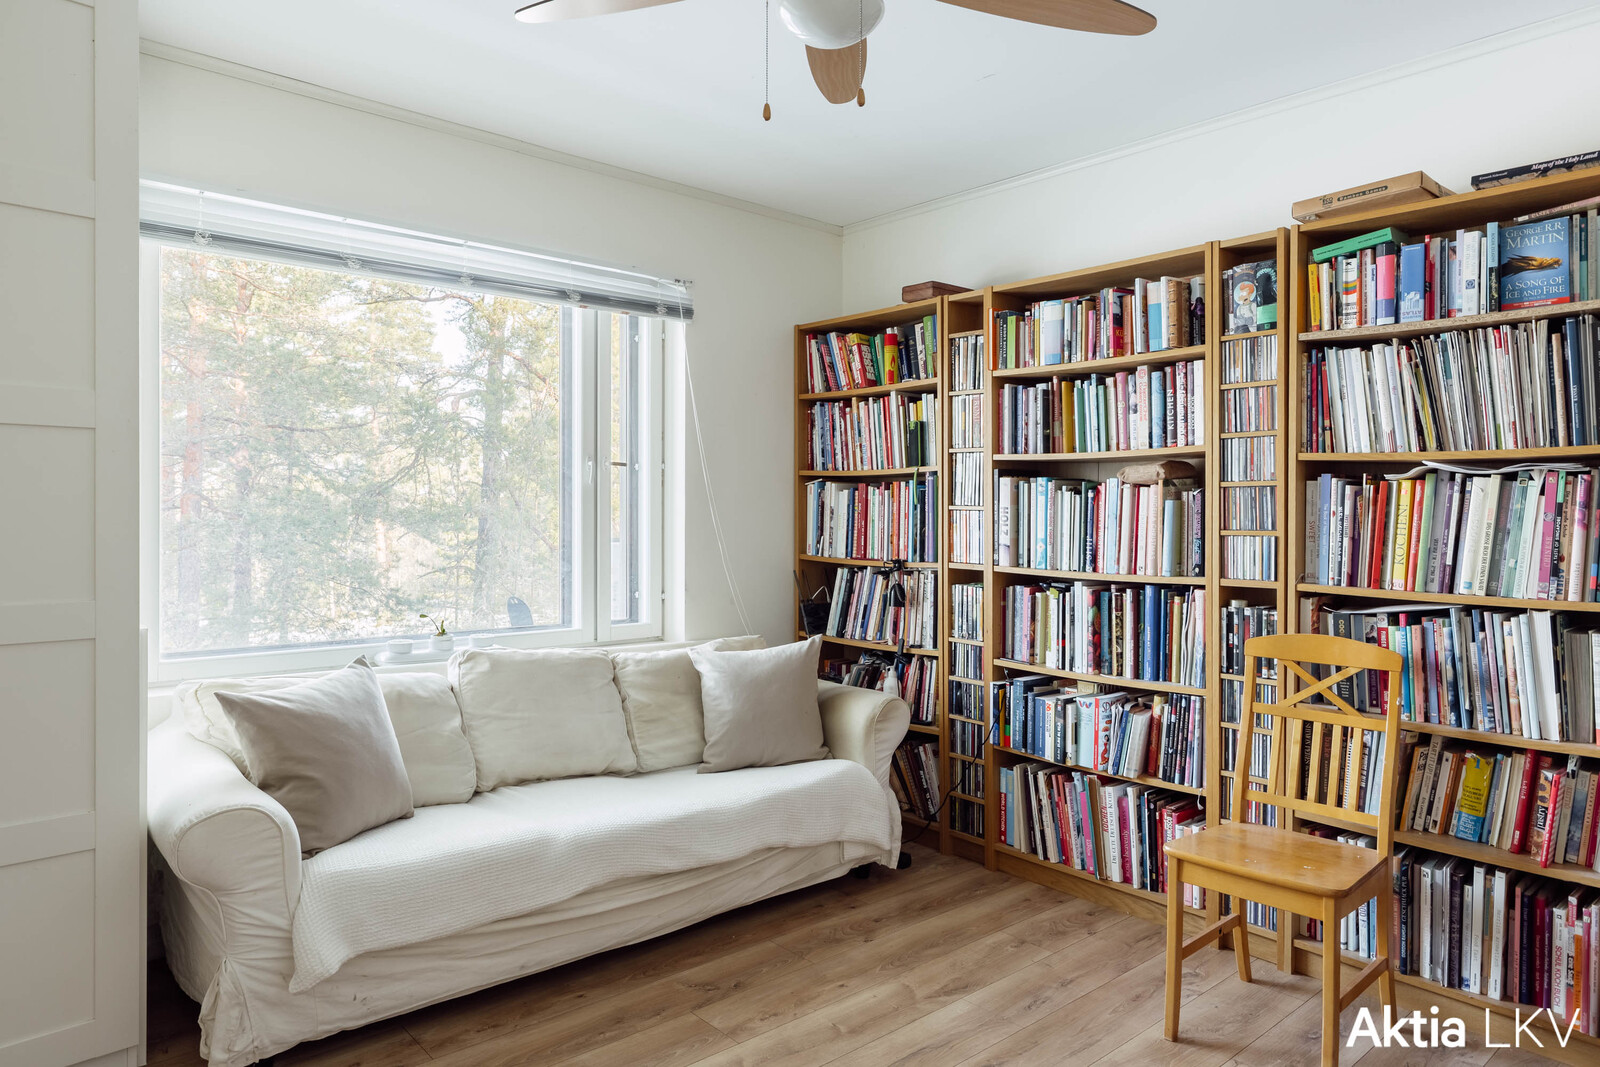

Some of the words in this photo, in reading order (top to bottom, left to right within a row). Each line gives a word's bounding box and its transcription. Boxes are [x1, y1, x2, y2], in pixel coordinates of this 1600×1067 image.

[1531, 161, 1547, 171] Maps
[1554, 158, 1565, 166] the
[1564, 155, 1580, 166] Holy
[1580, 152, 1598, 163] Land
[1505, 226, 1543, 238] GEORGE
[1545, 221, 1565, 232] R.R.
[1506, 232, 1564, 250] MARTIN
[1506, 290, 1520, 299] ICE
[1522, 288, 1542, 297] AND
[1544, 285, 1566, 295] FIRE
[1516, 277, 1547, 290] SONG
[1550, 276, 1565, 284] OF
[1166, 389, 1174, 430] KITCHEN
[1000, 506, 1008, 536] HOLZ
[1394, 504, 1409, 566] KOCHEN!
[1544, 536, 1552, 568] CHINESE
[1556, 568, 1565, 595] ASIEN
[1430, 742, 1438, 756] TART
[1426, 763, 1434, 774] UP!
[1536, 806, 1548, 828] pastry
[1122, 830, 1130, 857] heavenly
[1555, 945, 1563, 968] SCHUL
